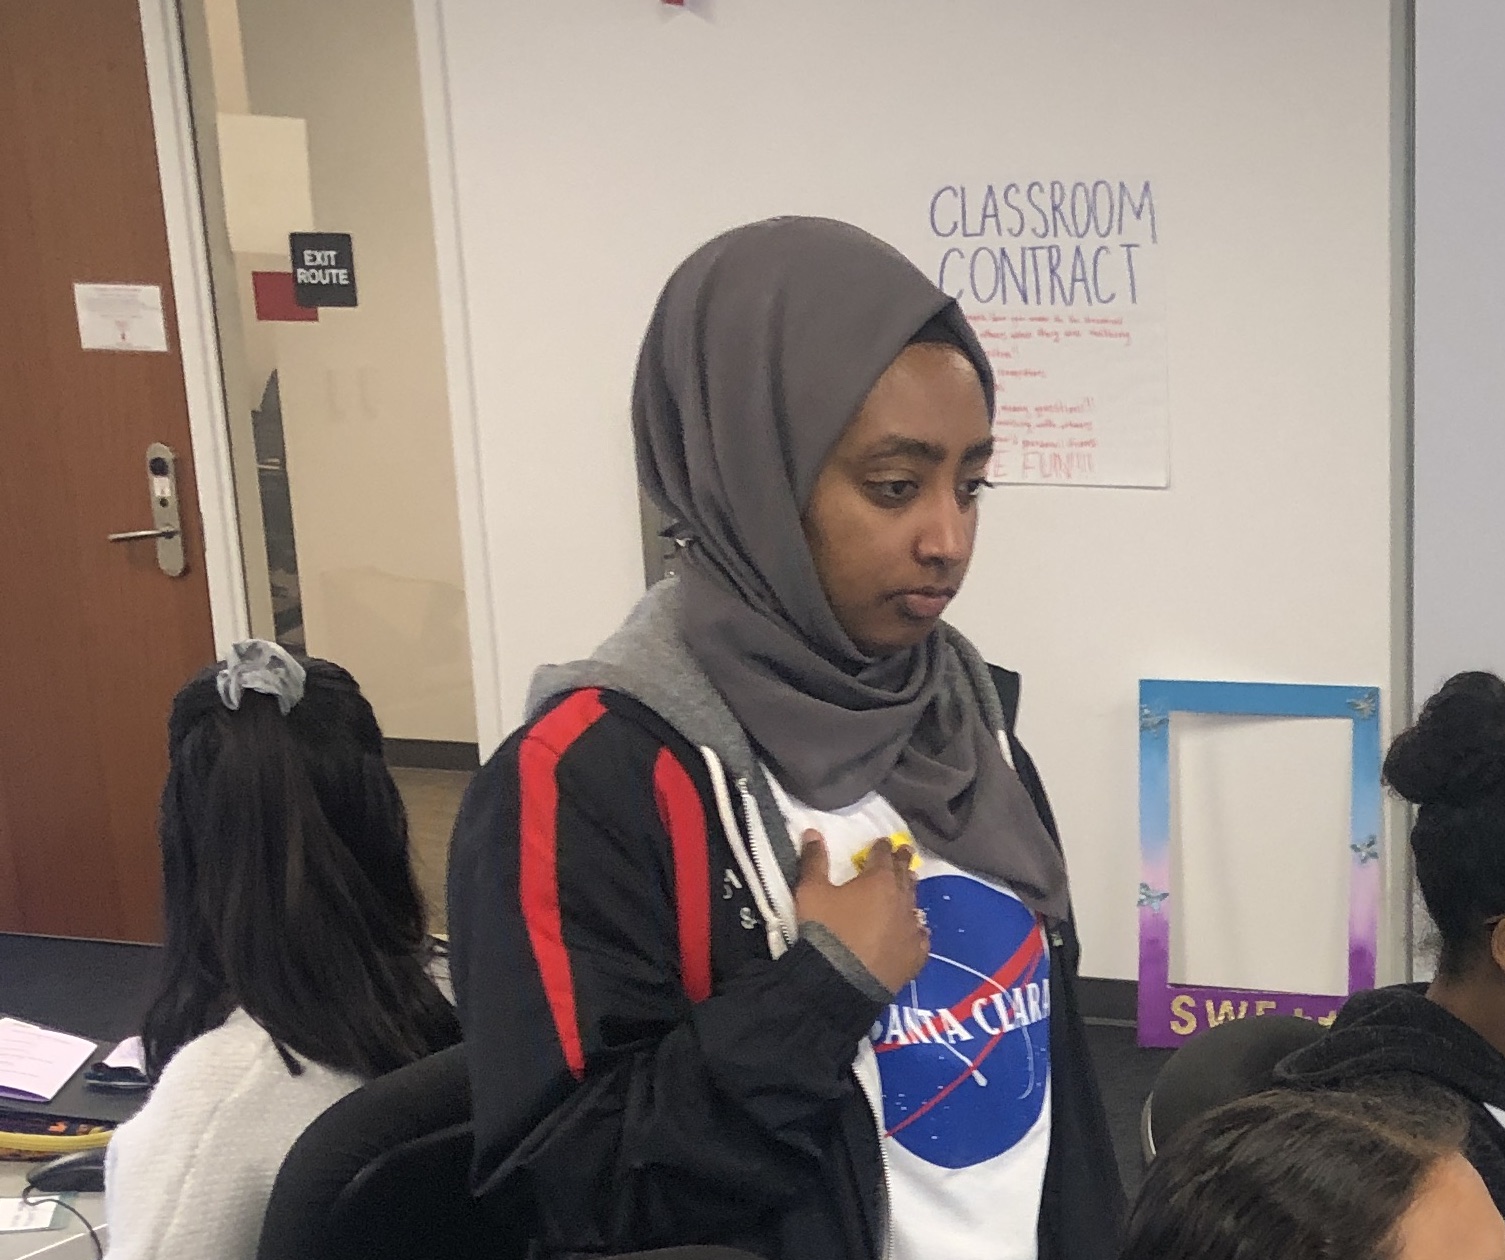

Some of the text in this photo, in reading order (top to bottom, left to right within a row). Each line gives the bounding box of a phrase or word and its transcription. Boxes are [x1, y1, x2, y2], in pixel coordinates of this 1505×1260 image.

[929, 180, 1158, 244] CLASSROOM
[297, 268, 350, 285] ROUTE
[303, 250, 337, 266] EXIT
[938, 243, 1141, 306] CONTRACT
